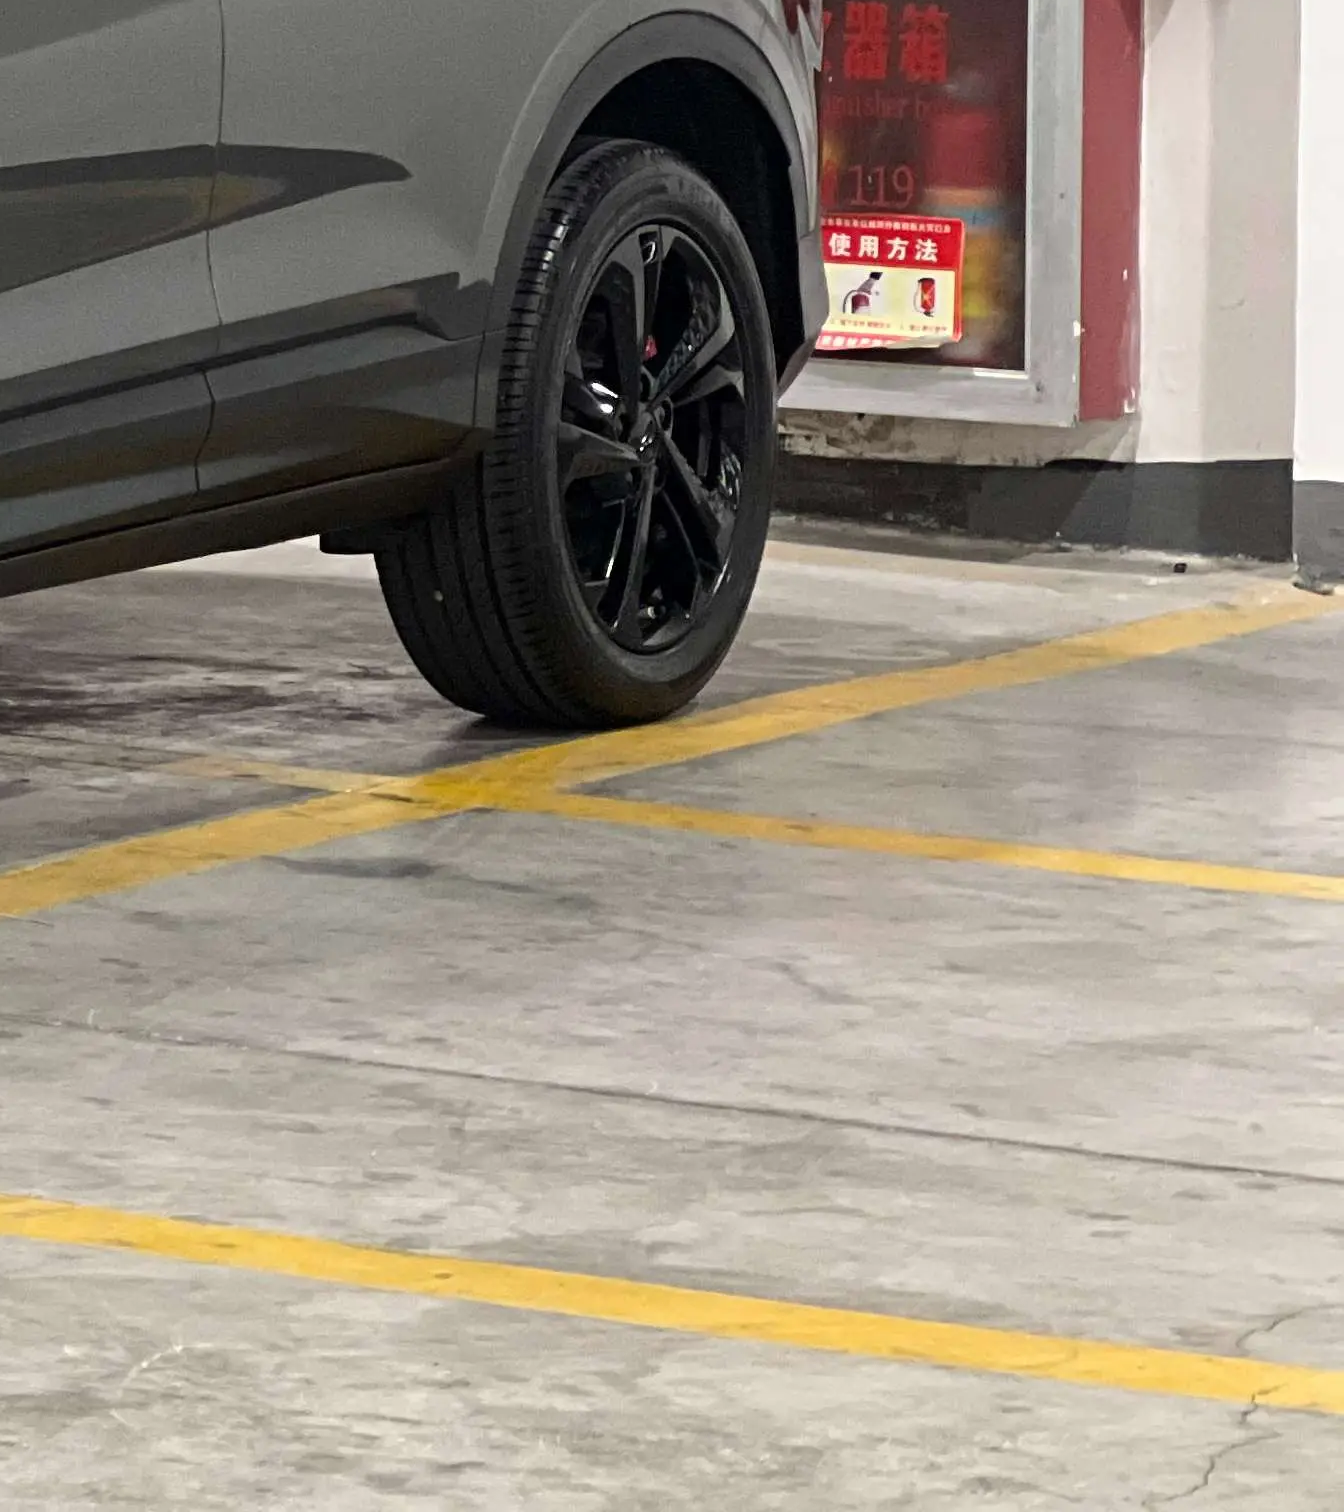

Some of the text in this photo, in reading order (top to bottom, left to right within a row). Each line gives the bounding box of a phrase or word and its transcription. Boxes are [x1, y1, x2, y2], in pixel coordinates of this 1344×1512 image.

[823, 1, 950, 83] 器箱
[847, 164, 916, 209] 119
[828, 233, 938, 262] 使用方法
